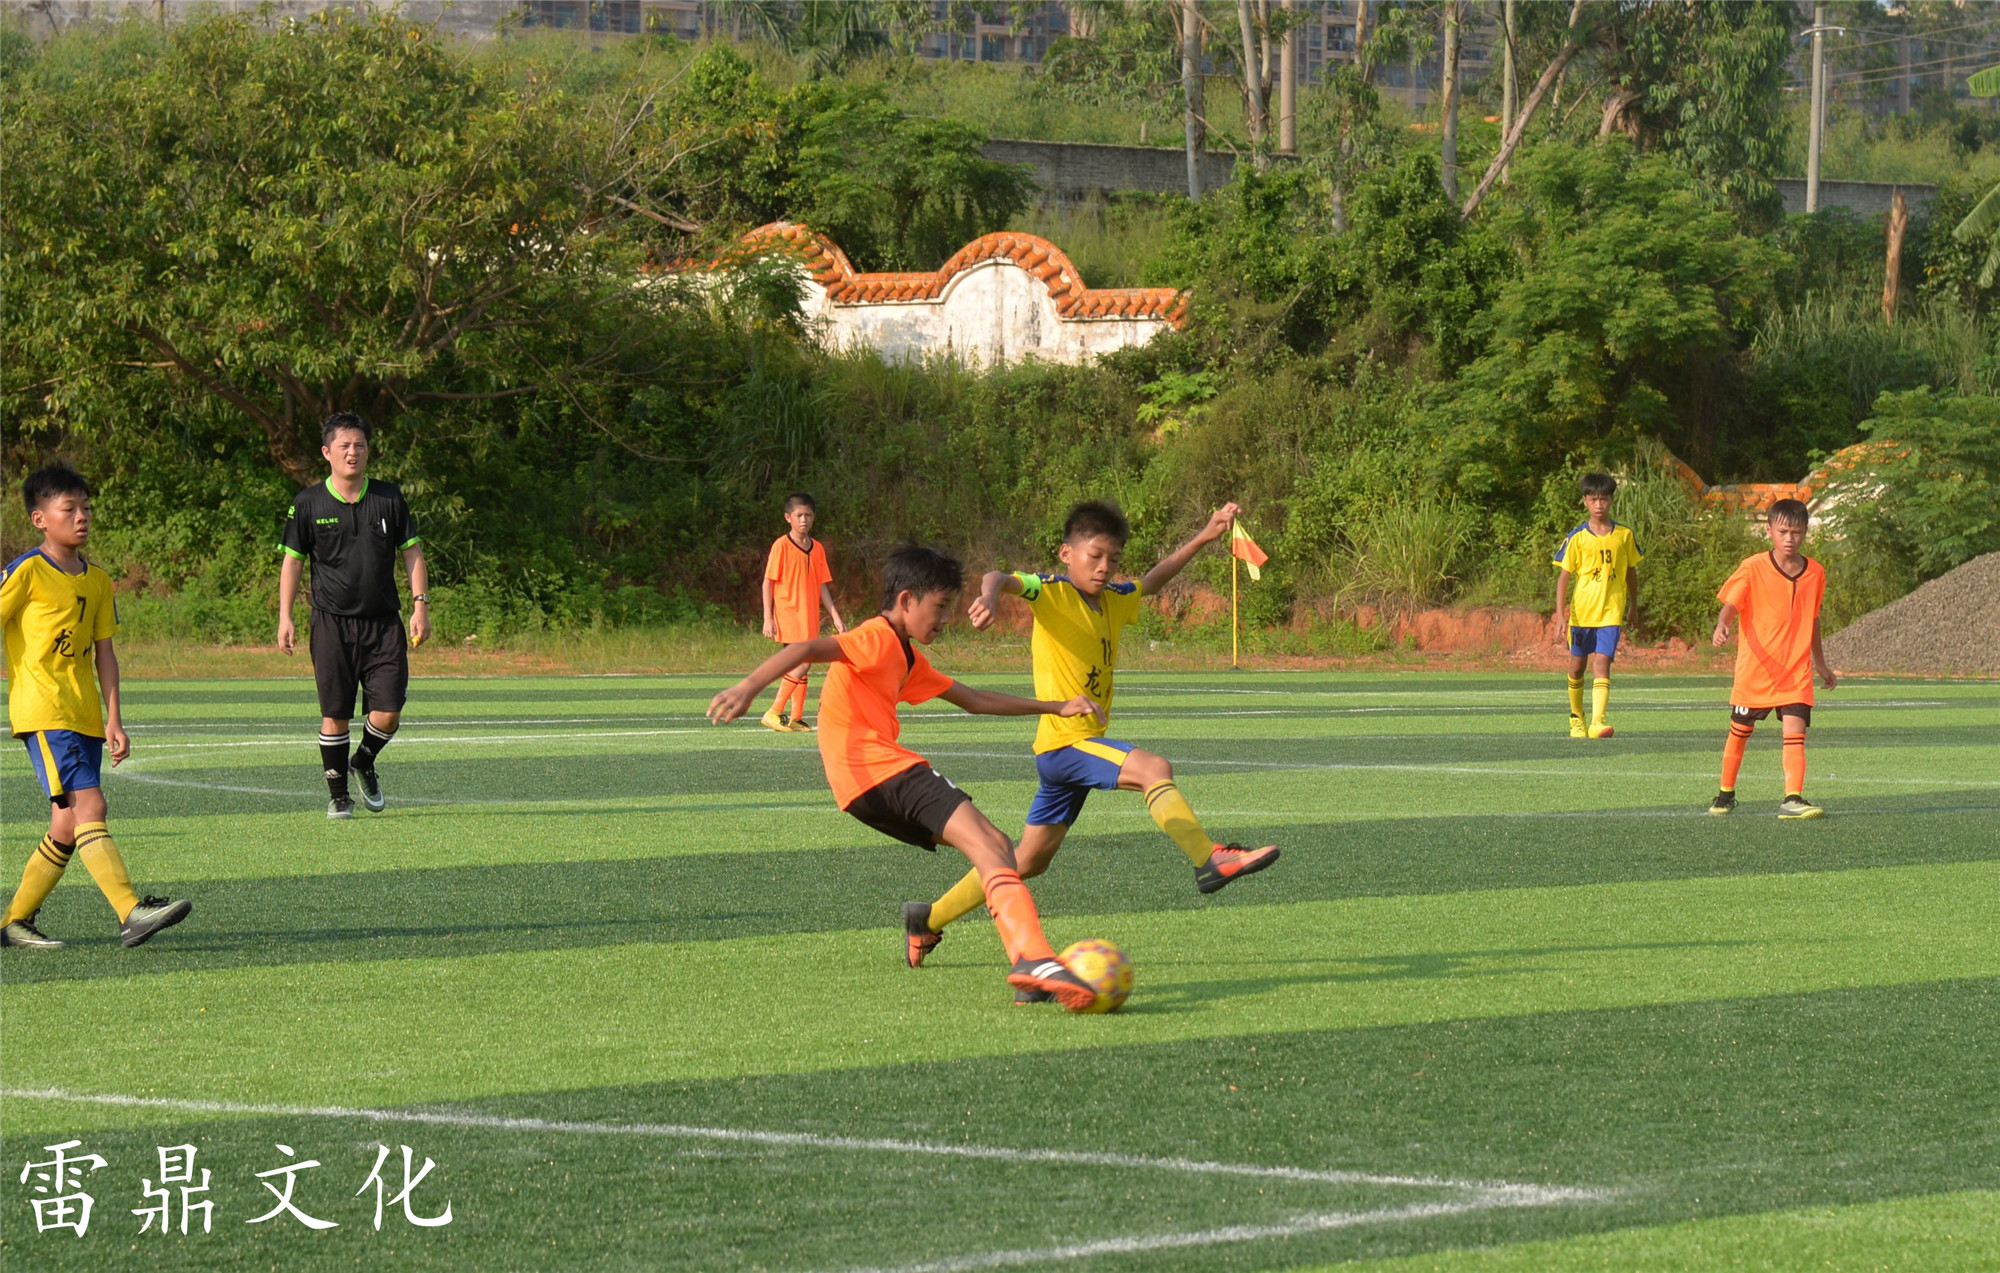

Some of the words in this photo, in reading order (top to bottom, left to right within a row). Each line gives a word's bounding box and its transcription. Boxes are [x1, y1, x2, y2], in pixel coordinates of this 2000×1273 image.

[315, 517, 339, 525] KELME
[1599, 549, 1612, 564] 13
[75, 594, 87, 624] 7
